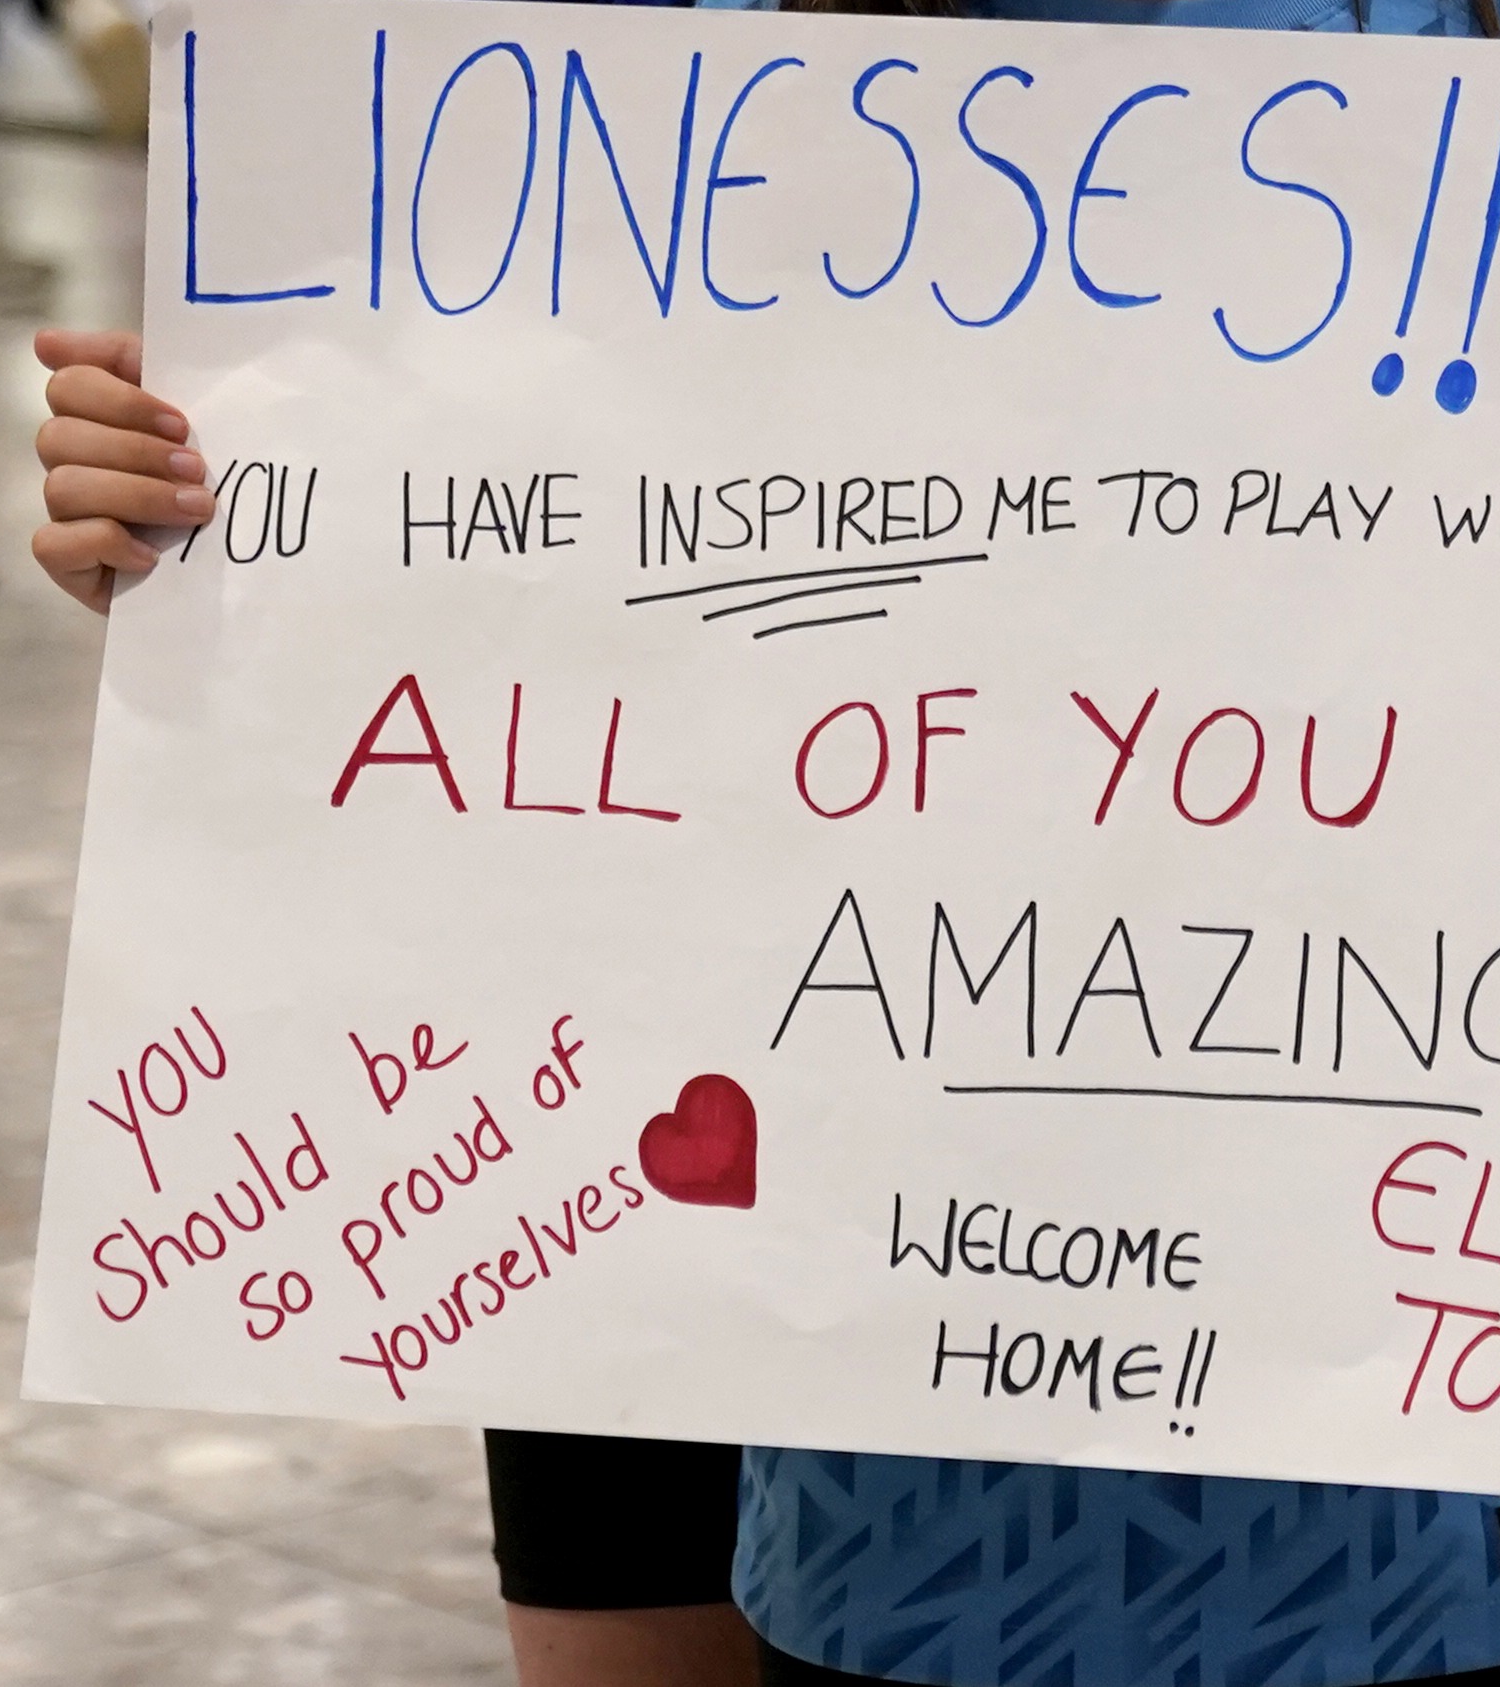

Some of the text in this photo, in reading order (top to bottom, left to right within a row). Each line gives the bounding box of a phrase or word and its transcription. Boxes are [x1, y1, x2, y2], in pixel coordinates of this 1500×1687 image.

[404, 471, 582, 567] HAVE
[639, 473, 964, 569] INSPIRED
[987, 476, 1076, 541] ME
[1098, 469, 1198, 537] TO
[1224, 470, 1393, 542] PLAY
[331, 674, 681, 822] ALL
[795, 688, 977, 819] OF
[1070, 688, 1397, 828] YOU
[348, 1024, 469, 1115] be
[341, 1095, 513, 1300] proud
[533, 1015, 584, 1110] of
[341, 1165, 644, 1400] yourselves
[890, 1193, 1202, 1290] WELCOME
[932, 1320, 1217, 1437] HOME!!
